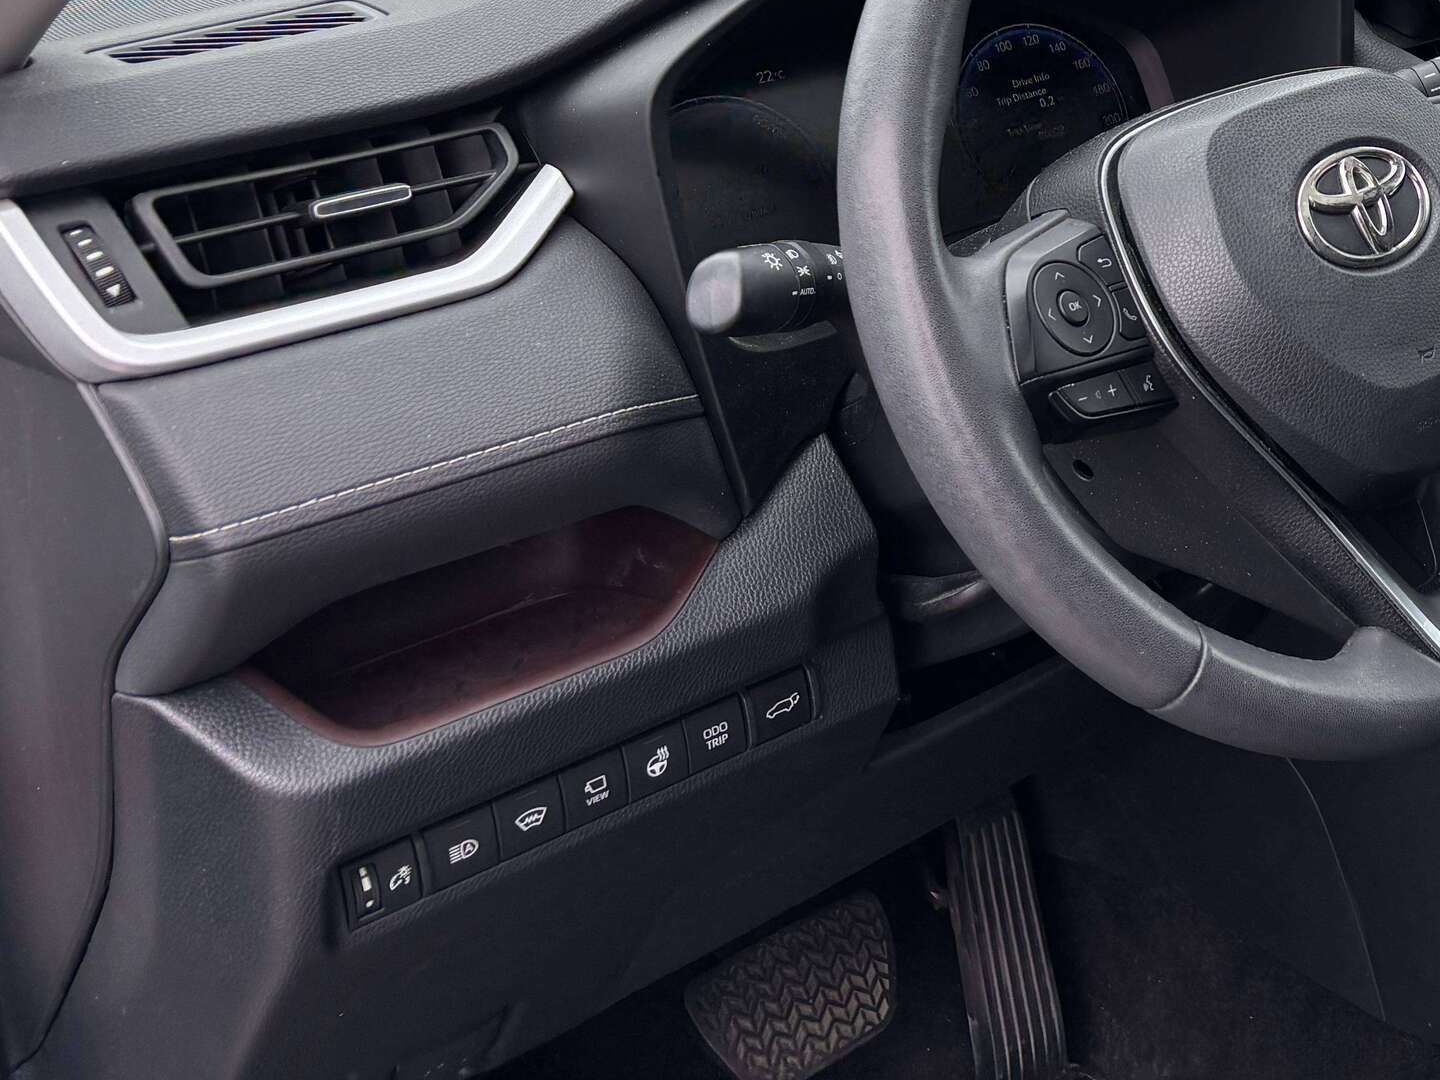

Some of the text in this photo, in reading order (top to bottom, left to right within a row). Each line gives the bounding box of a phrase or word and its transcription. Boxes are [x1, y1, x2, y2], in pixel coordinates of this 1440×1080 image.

[995, 39, 1013, 53] 100
[1023, 34, 1040, 47] 120
[1049, 40, 1066, 53] 140
[977, 59, 990, 71] 80
[1012, 77, 1033, 88] Drive
[997, 88, 1047, 107] Trip Distance
[1039, 96, 1055, 108] 0.2
[800, 287, 815, 296] AUTO
[1068, 301, 1082, 312] OK
[703, 721, 728, 740] ODO
[706, 733, 729, 751] TRIP
[586, 789, 610, 806] VIEW
